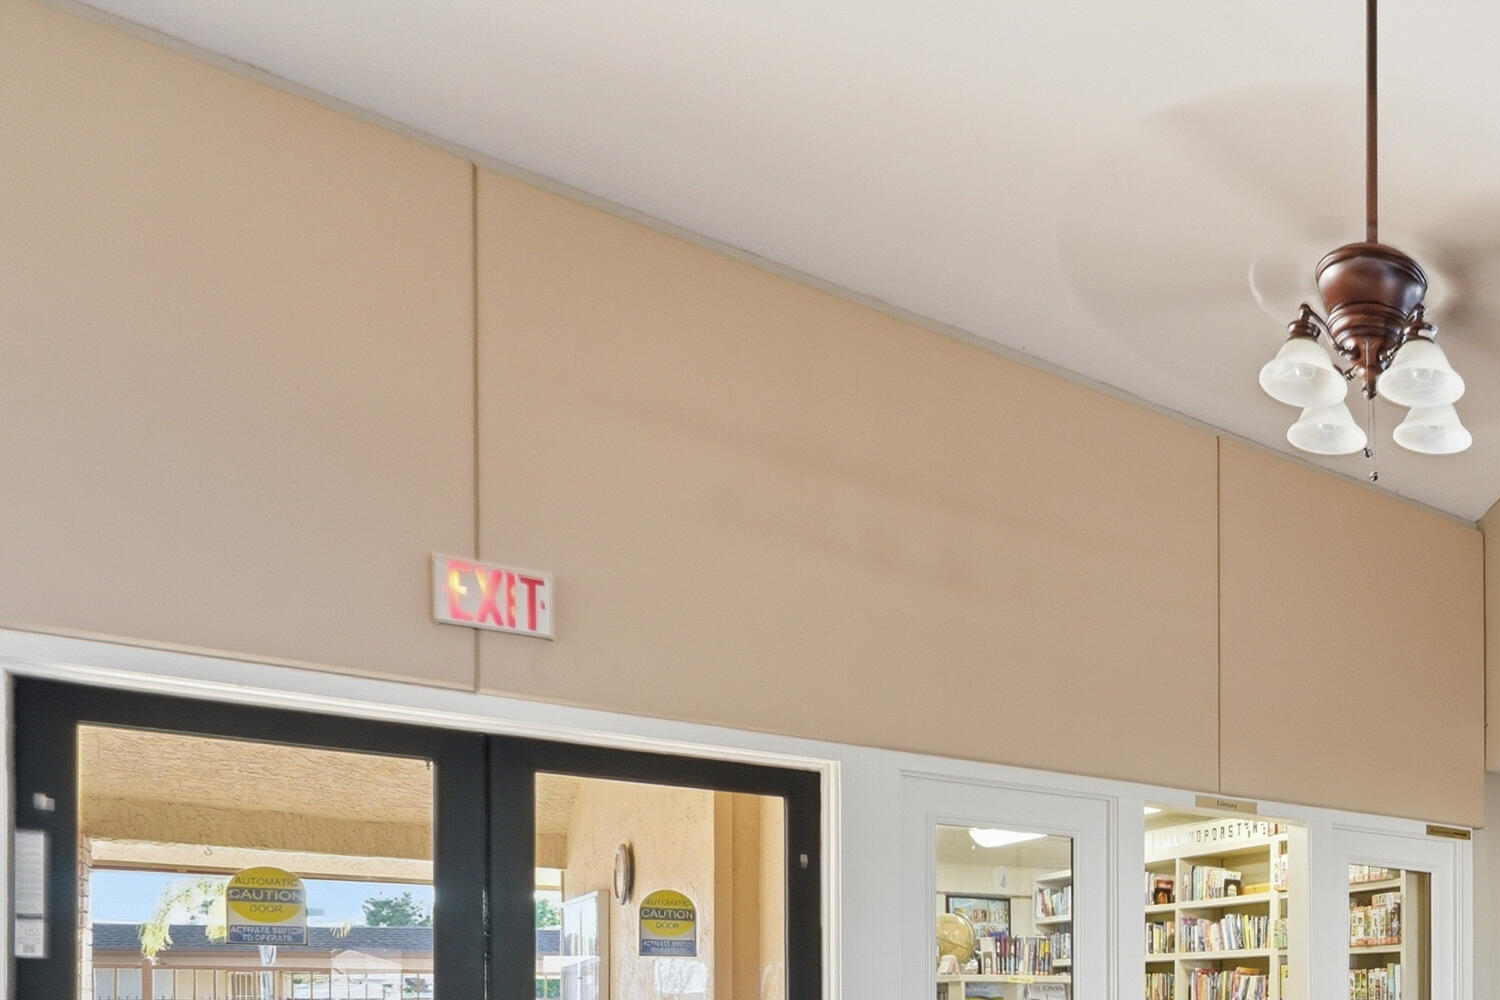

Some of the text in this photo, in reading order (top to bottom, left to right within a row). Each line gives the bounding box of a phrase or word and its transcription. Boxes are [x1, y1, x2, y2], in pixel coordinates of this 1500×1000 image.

[446, 558, 545, 632] EXIT
[234, 876, 300, 888] AUTOMATIC
[228, 888, 304, 902] CAUTION
[249, 903, 284, 913] DOOR
[641, 907, 694, 920] CAUTION
